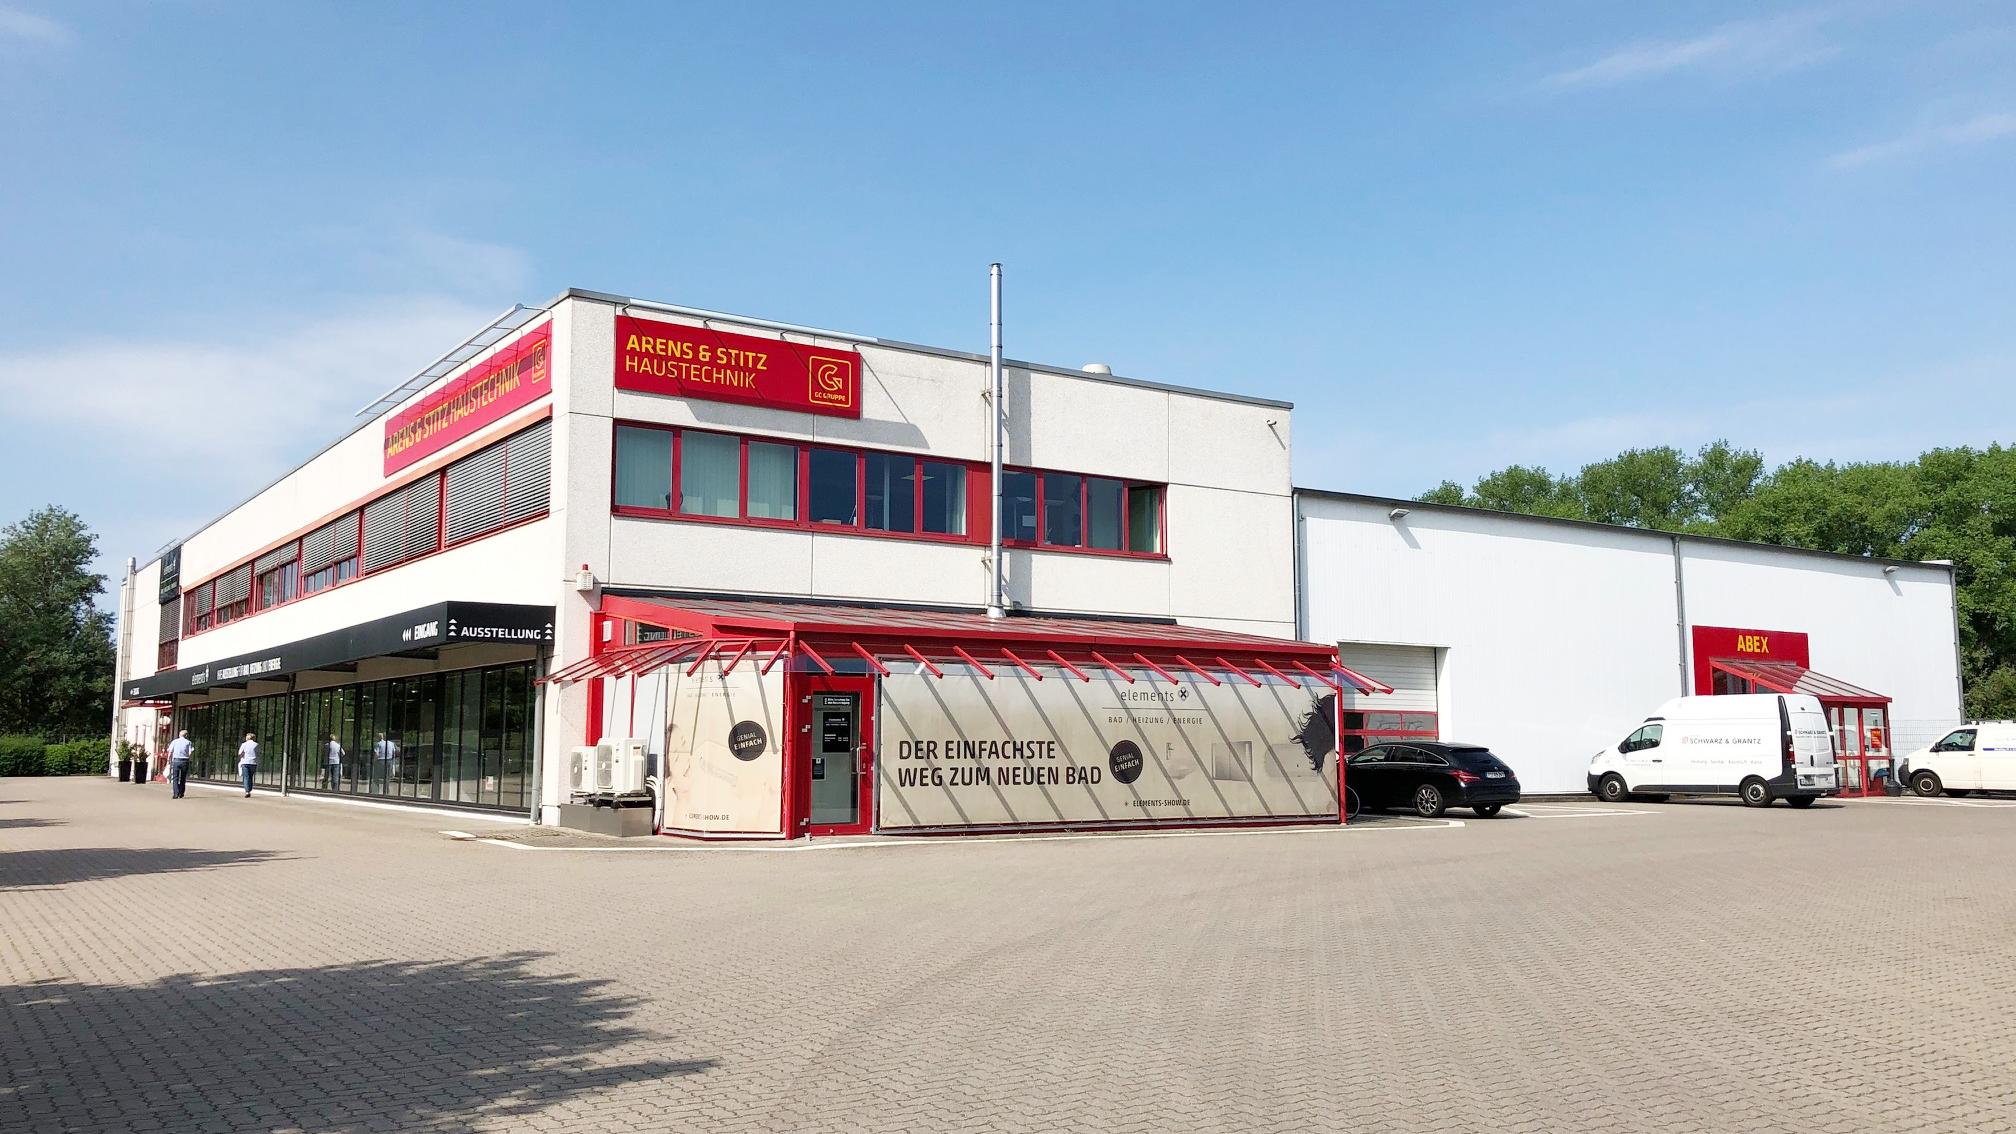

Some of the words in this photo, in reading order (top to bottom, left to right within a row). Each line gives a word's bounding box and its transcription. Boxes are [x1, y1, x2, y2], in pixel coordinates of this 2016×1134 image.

[626, 334, 693, 359] ARENS
[699, 345, 712, 362] &
[716, 347, 768, 370] STITZ
[625, 355, 756, 389] HAUSTECHNIK
[386, 422, 415, 458] ARENS
[423, 403, 449, 439] STITZ
[449, 360, 521, 425] HAUSTECHNIK
[414, 621, 438, 640] EINGANG
[461, 626, 541, 640] AUSSTELLUNG
[1737, 634, 1769, 653] ABEX
[1120, 689, 1175, 702] elements
[1173, 717, 1203, 725] ENERGIE
[734, 738, 762, 751] EINFACH
[737, 732, 757, 742] GENIAL
[899, 740, 938, 760] DER
[945, 740, 1056, 760] EINFACHSTE
[1114, 759, 1140, 772] EINFACH
[898, 767, 943, 787] WEG
[949, 767, 991, 786] ZUM
[998, 766, 1059, 786] NEUEN
[1066, 766, 1102, 785] BAD
[1132, 799, 1191, 807] ELEMENTS-SHOW.DE
